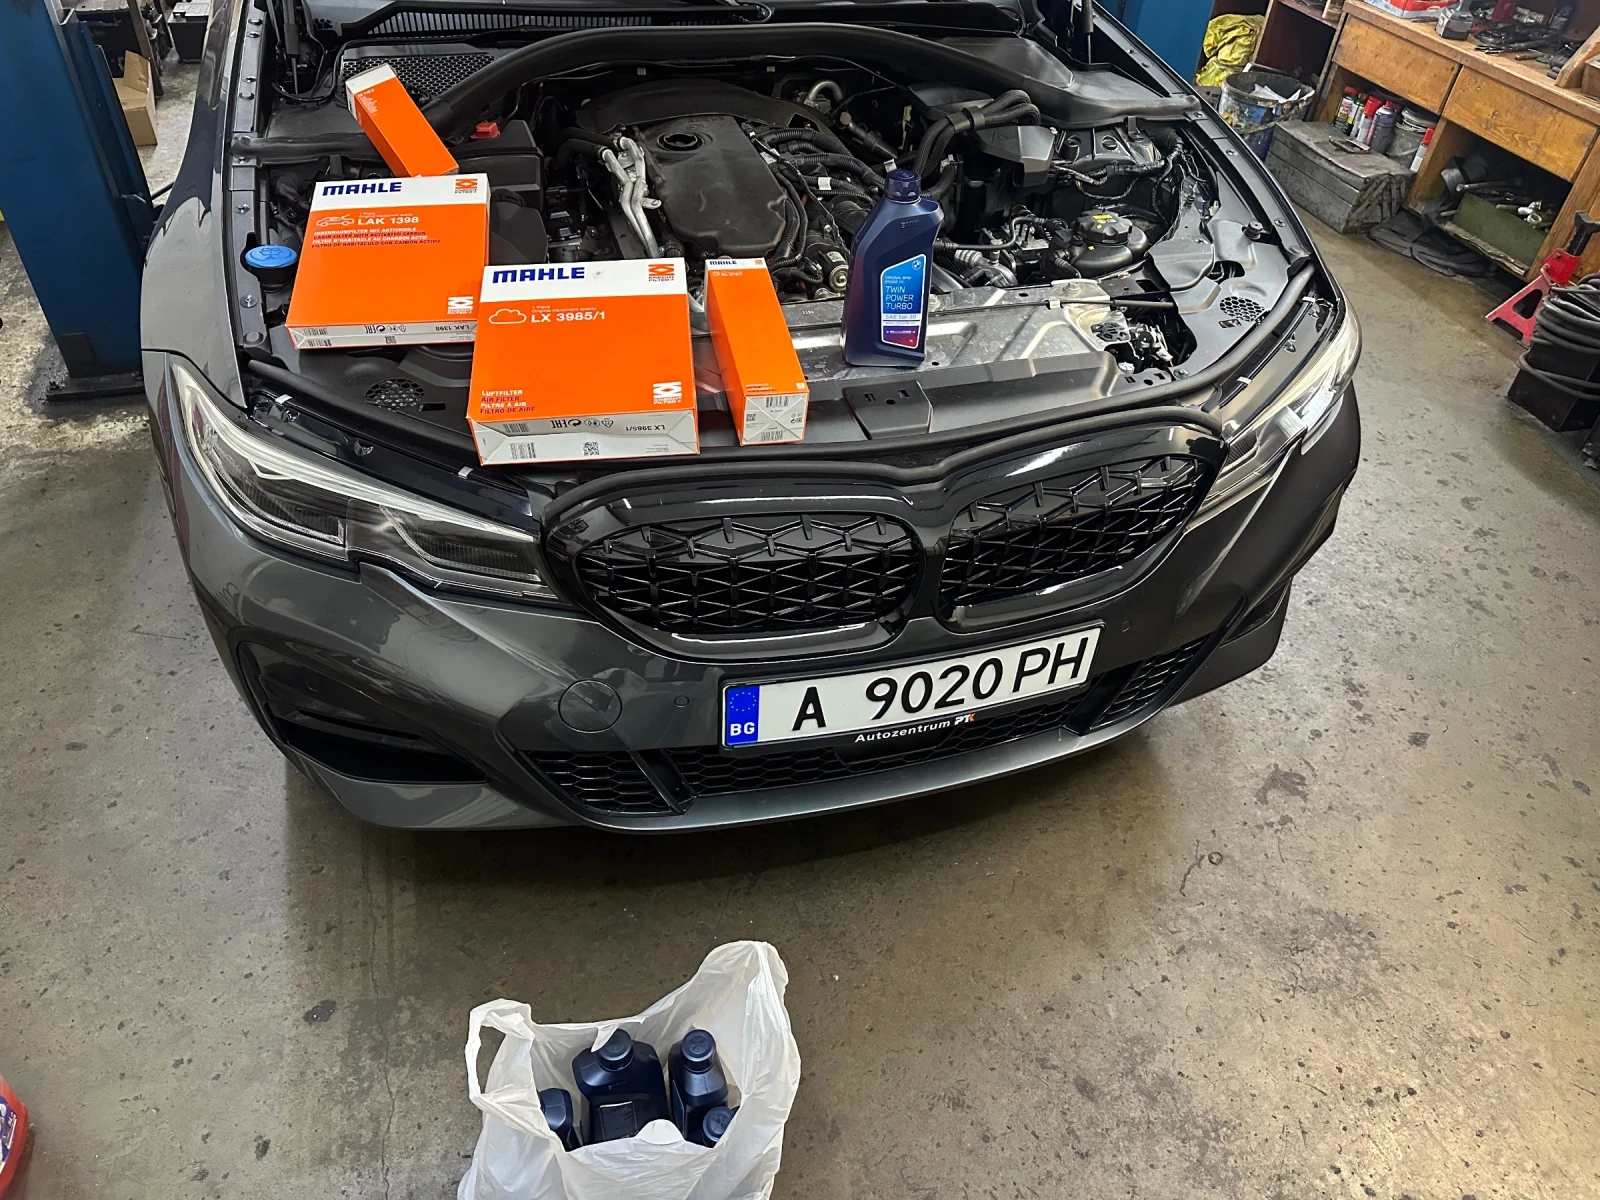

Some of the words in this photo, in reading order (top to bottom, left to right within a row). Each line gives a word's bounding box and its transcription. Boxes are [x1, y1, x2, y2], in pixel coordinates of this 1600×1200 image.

[322, 182, 402, 196] MAHLE
[358, 217, 385, 226] LAK
[390, 216, 419, 224] 1398
[492, 267, 585, 284] MAHLE
[885, 285, 906, 293] TWIN
[885, 294, 914, 302] POWER
[885, 302, 913, 310] TURBO
[531, 314, 551, 323] LX
[556, 311, 605, 322] 3985/1
[791, 687, 827, 731] A
[865, 657, 1003, 720] 9020
[1012, 637, 1089, 693] PH
[730, 722, 755, 737] BG
[854, 720, 951, 743] Autozentrum
